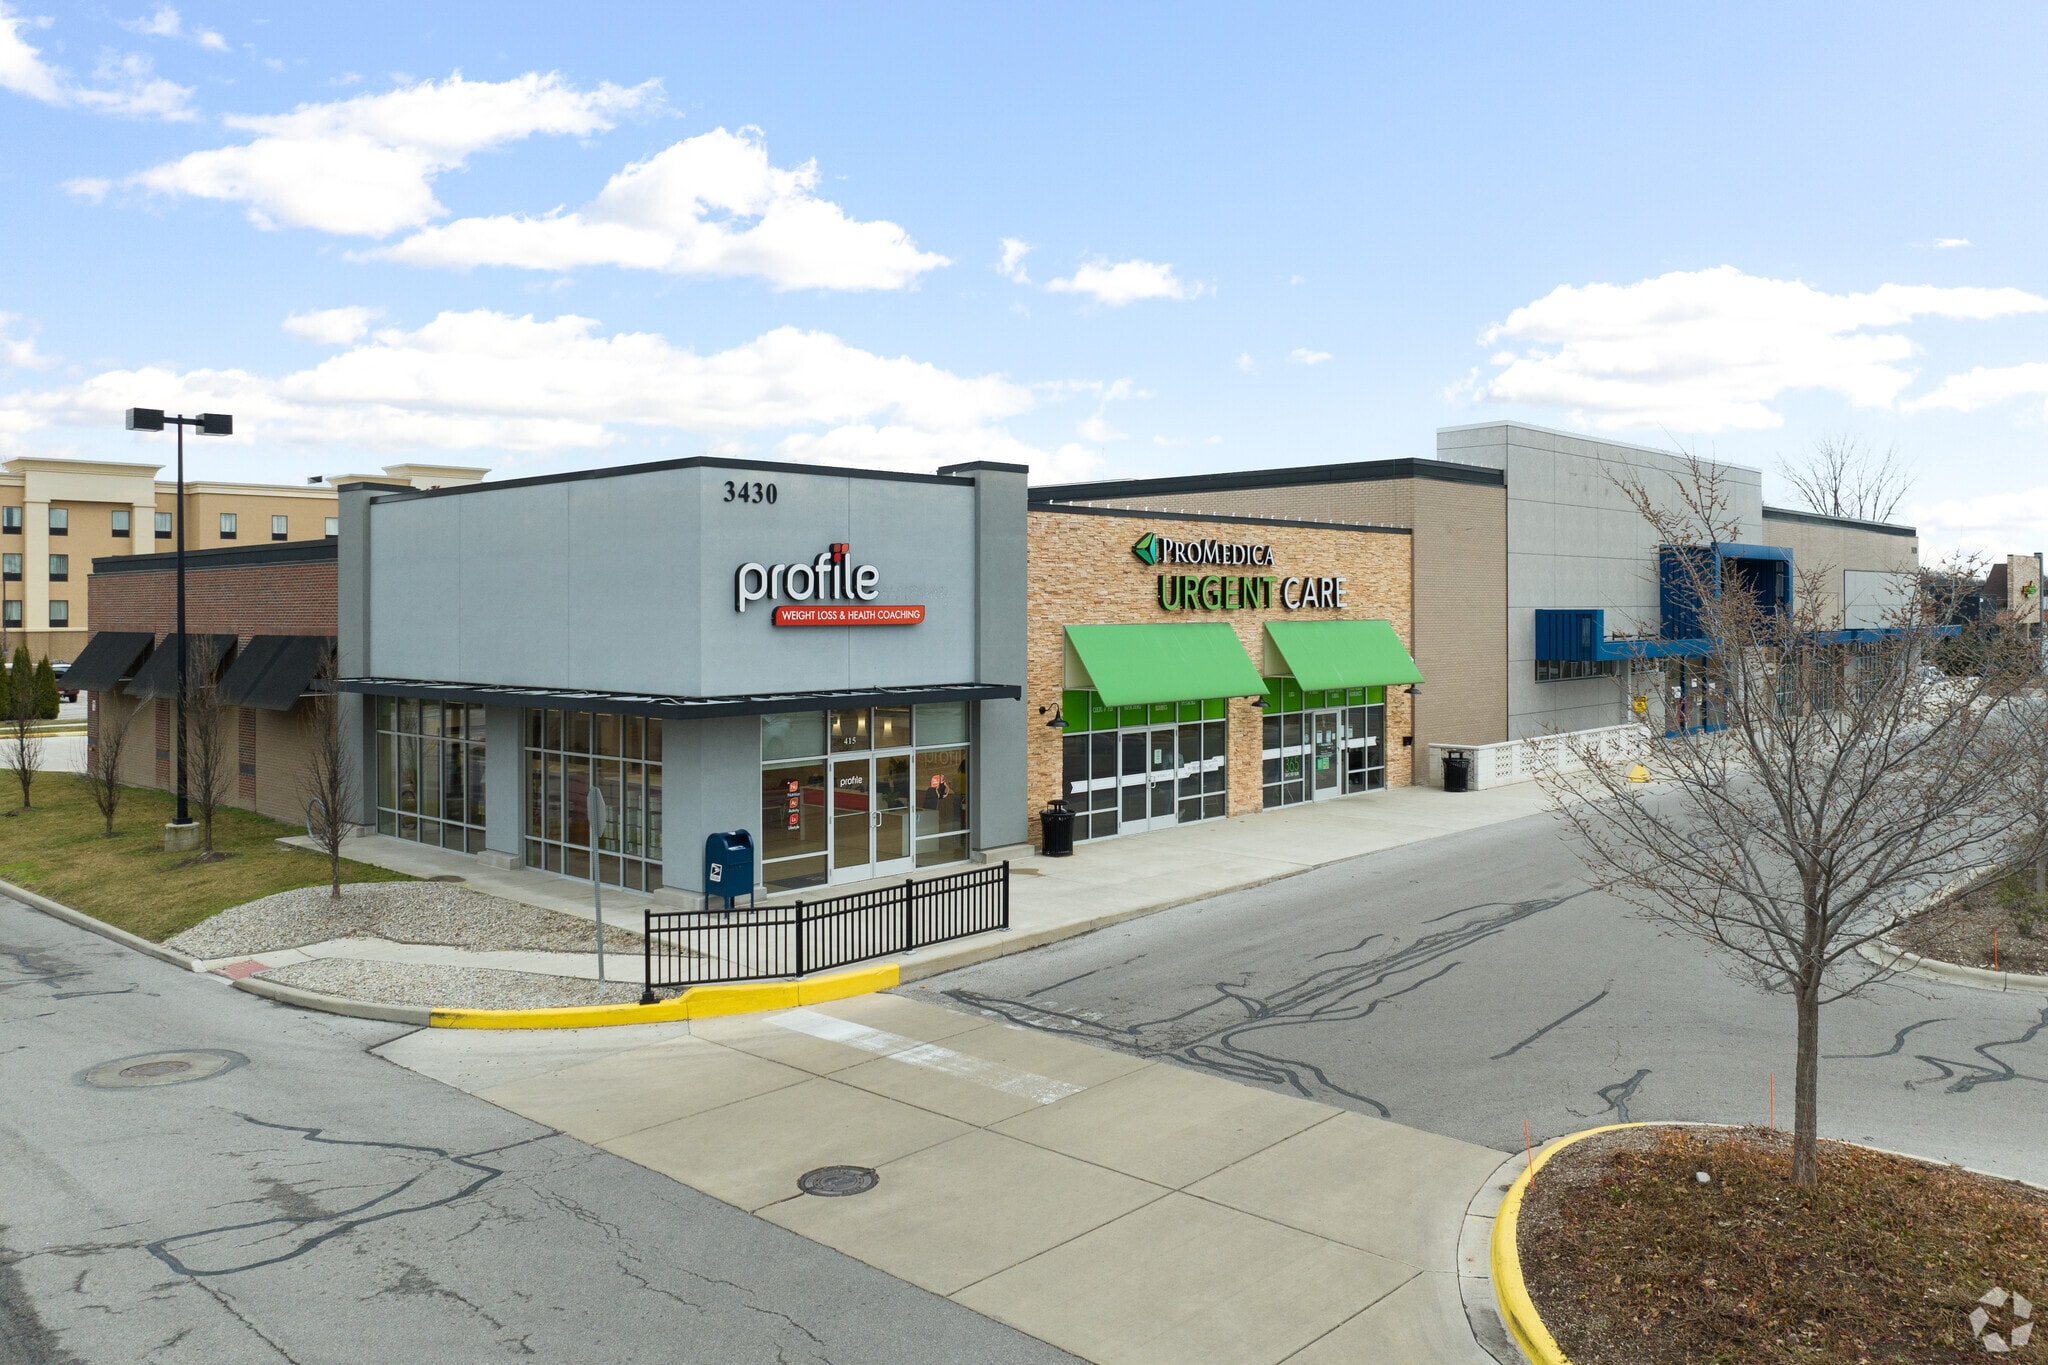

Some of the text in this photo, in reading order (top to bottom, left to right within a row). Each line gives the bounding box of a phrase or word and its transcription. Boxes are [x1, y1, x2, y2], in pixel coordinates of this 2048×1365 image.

[723, 480, 778, 505] 3430
[735, 543, 880, 613] profile
[1158, 575, 1348, 611] URGENT CARE
[781, 609, 921, 621] WEIGHT LOSS & HEALTH COACHING
[843, 736, 857, 745] 415
[1285, 757, 1300, 773] 365
[840, 775, 863, 788] profile
